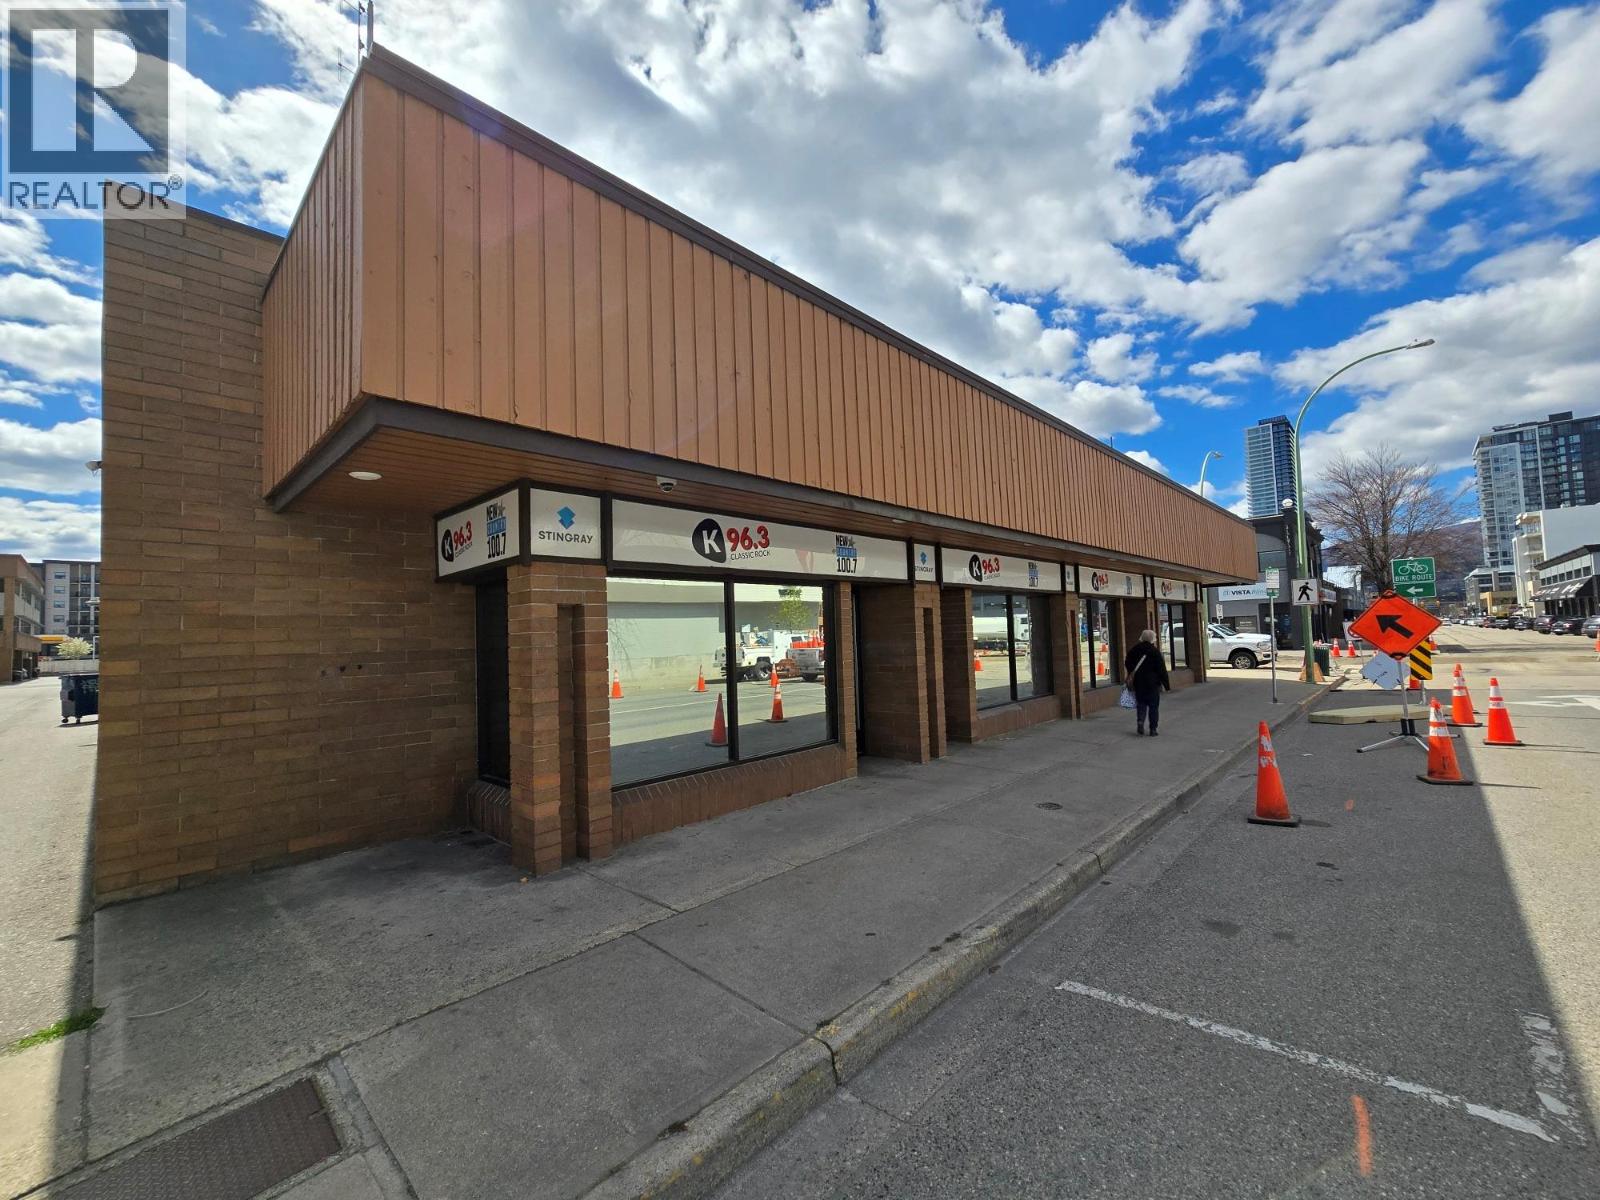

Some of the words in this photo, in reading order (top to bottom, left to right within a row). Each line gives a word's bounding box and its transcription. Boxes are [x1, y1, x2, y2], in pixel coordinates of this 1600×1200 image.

[487, 502, 499, 521] NEW
[453, 520, 473, 551] 96.3
[538, 530, 593, 544] STINGRAY
[726, 525, 770, 553] 96.3
[836, 534, 849, 547] NEW
[487, 532, 507, 559] 100.7
[730, 551, 754, 561] CLASSIC
[754, 549, 771, 558] ROCK
[837, 558, 857, 574] 100.7
[982, 557, 1000, 574] 96.3
